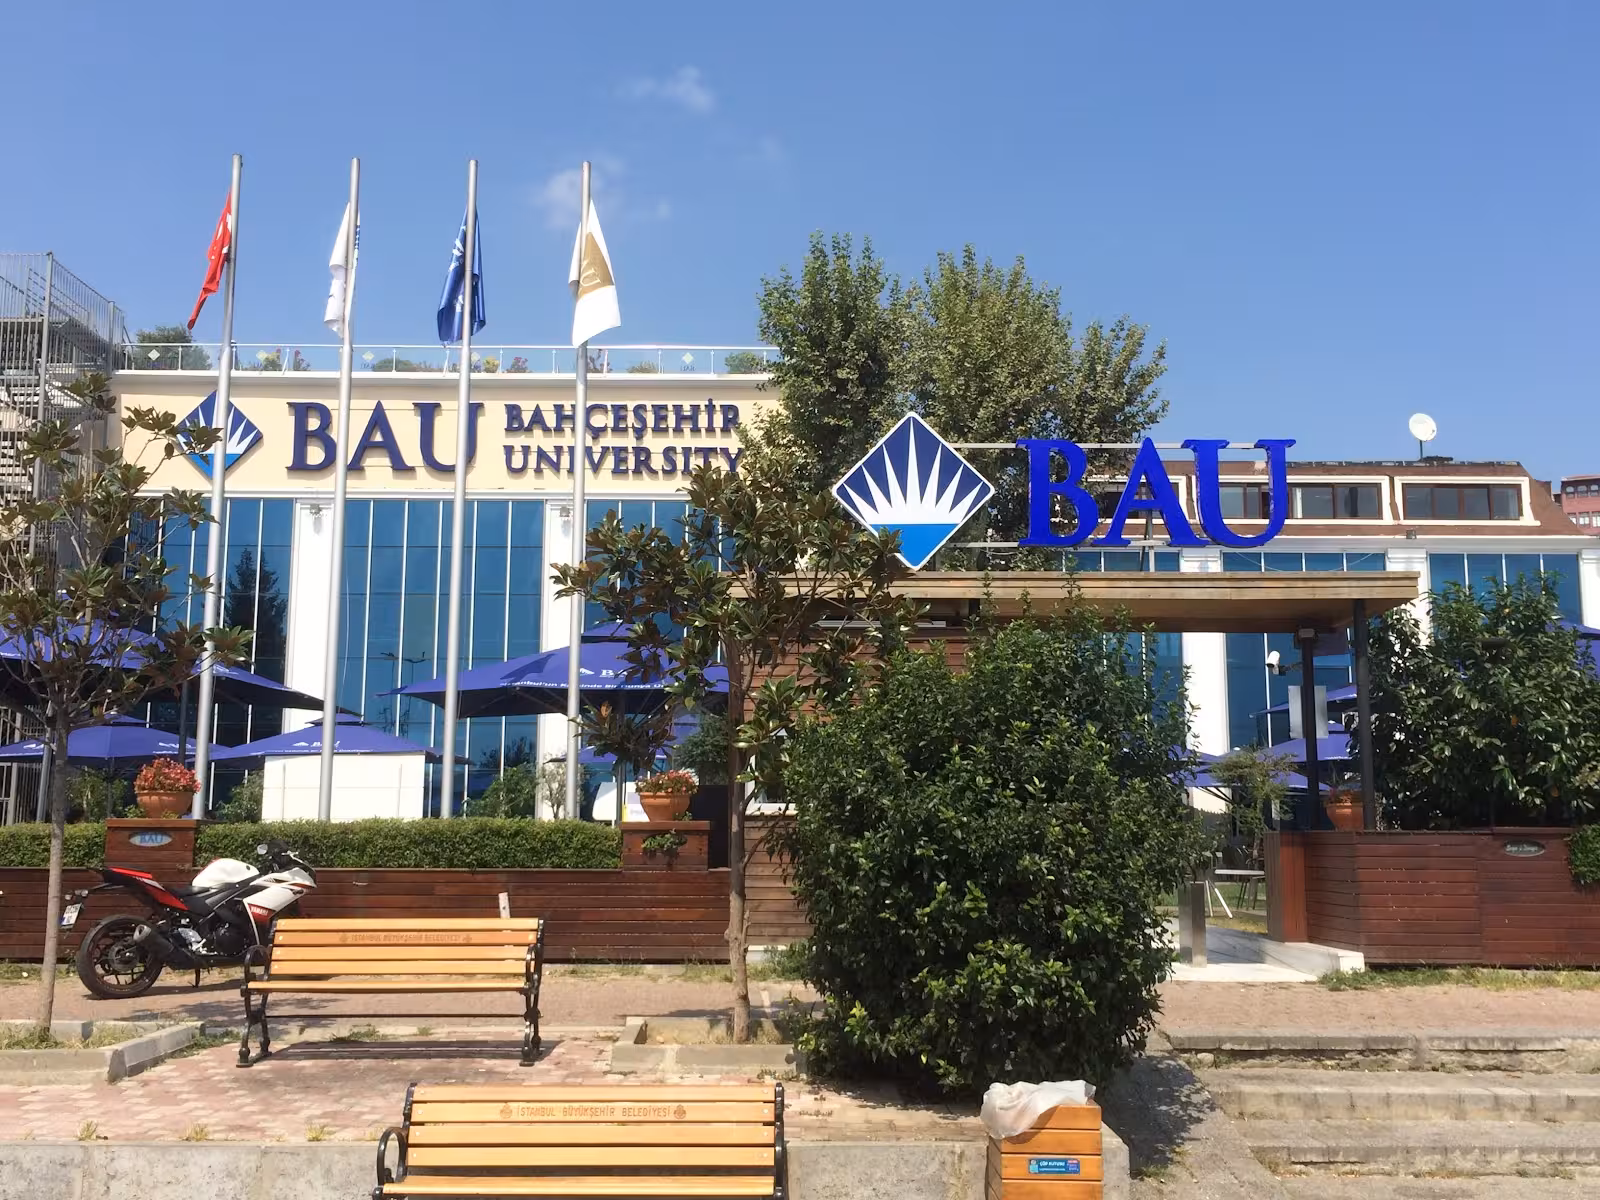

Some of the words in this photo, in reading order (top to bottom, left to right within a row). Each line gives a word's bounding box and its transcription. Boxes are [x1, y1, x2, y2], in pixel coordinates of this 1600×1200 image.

[284, 400, 484, 473] BAU
[504, 397, 740, 440] BAHÇEŞEHİR
[502, 444, 743, 475] UNIVERSITY
[1015, 436, 1297, 549] BAU
